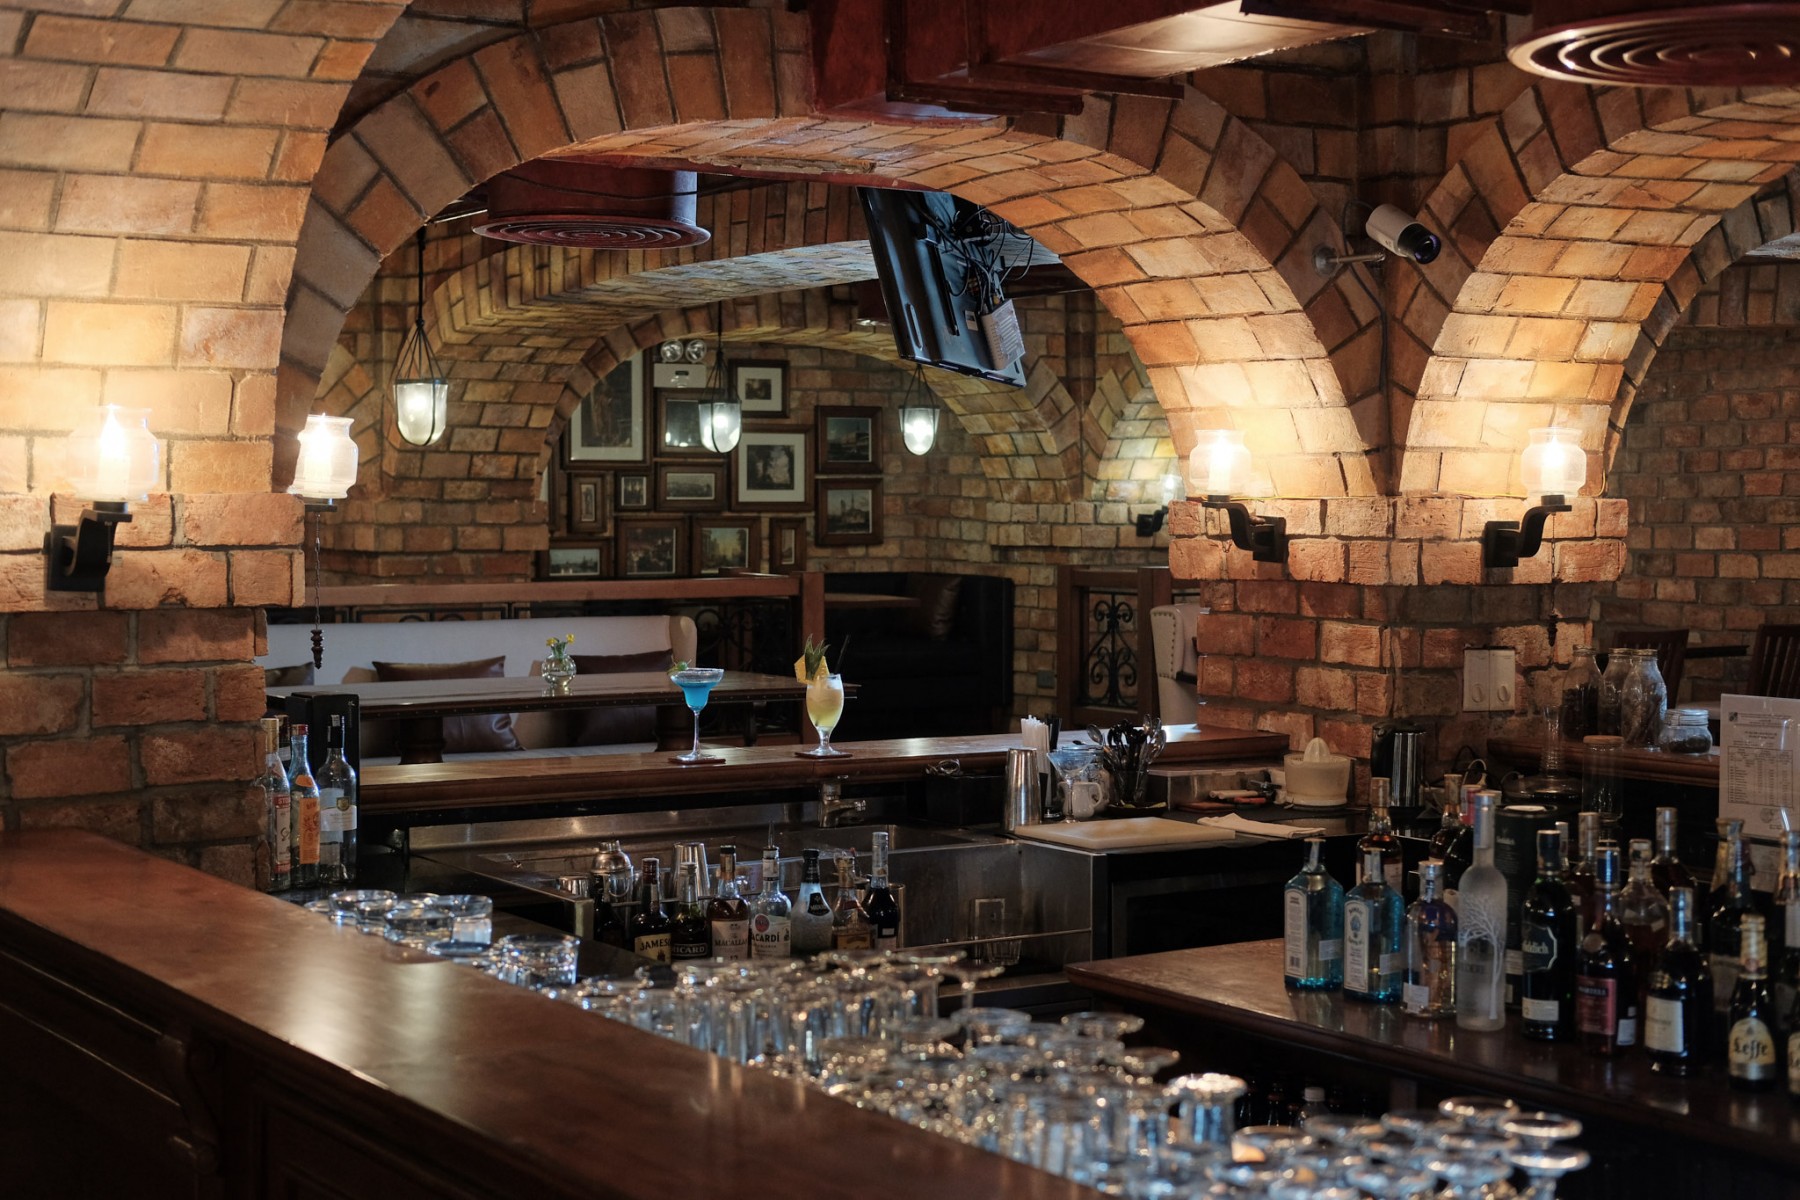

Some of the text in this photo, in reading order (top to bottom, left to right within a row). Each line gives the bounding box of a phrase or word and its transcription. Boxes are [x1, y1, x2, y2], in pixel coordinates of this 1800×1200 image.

[752, 931, 780, 943] ACARDÍ
[640, 938, 672, 951] JAMES
[673, 945, 706, 955] ICARD
[1733, 1035, 1768, 1060] Leffe
